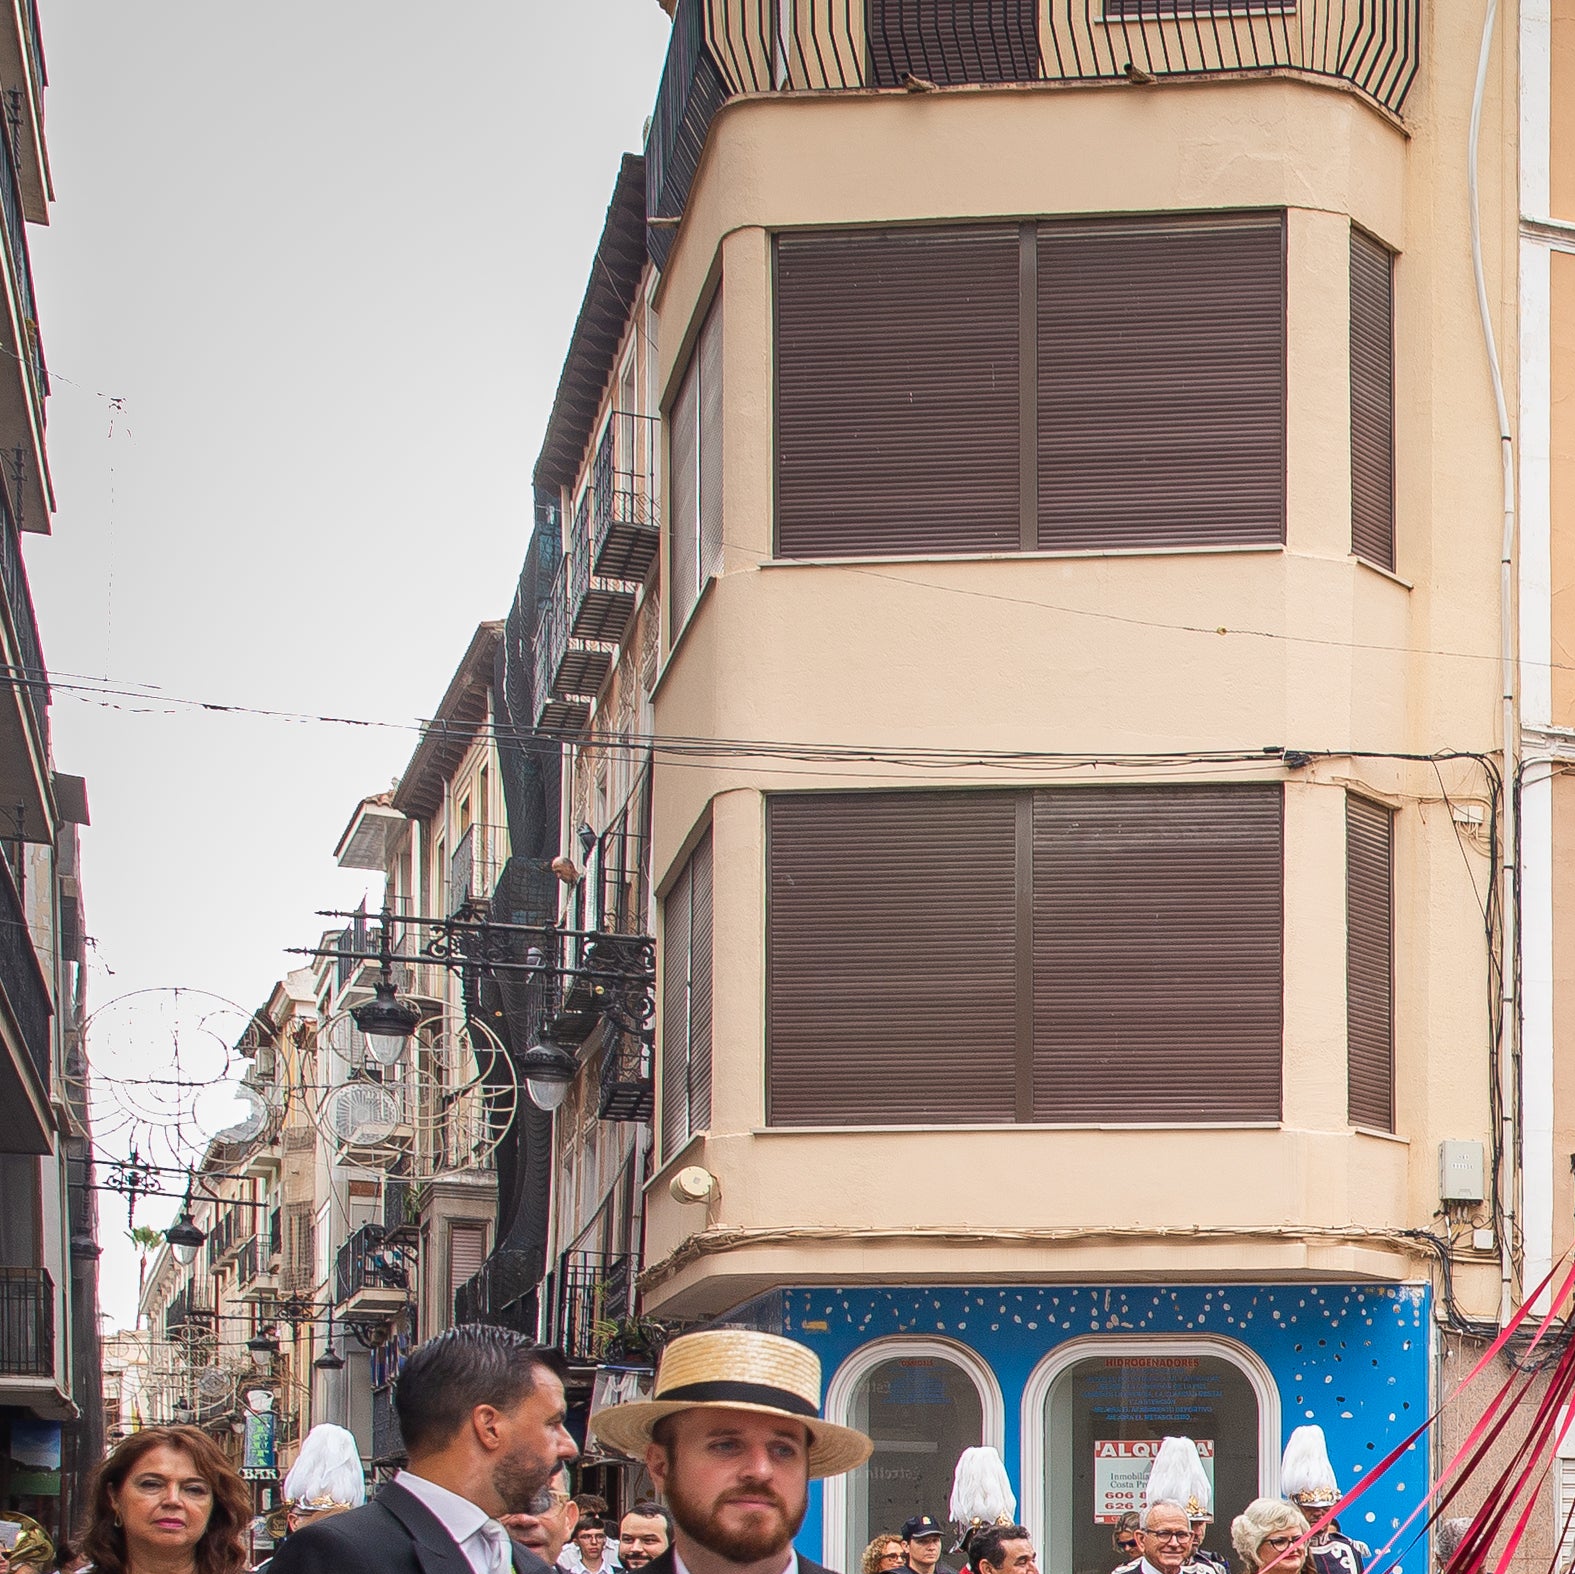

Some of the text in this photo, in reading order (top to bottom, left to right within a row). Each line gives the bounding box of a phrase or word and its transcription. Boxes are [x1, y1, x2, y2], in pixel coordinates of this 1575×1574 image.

[1105, 1358, 1200, 1367] HIDROGENADORES
[242, 1468, 278, 1480] BAR
[1111, 1481, 1135, 1489] Costa
[1105, 1491, 1134, 1500] 606
[1105, 1502, 1134, 1510] 626
